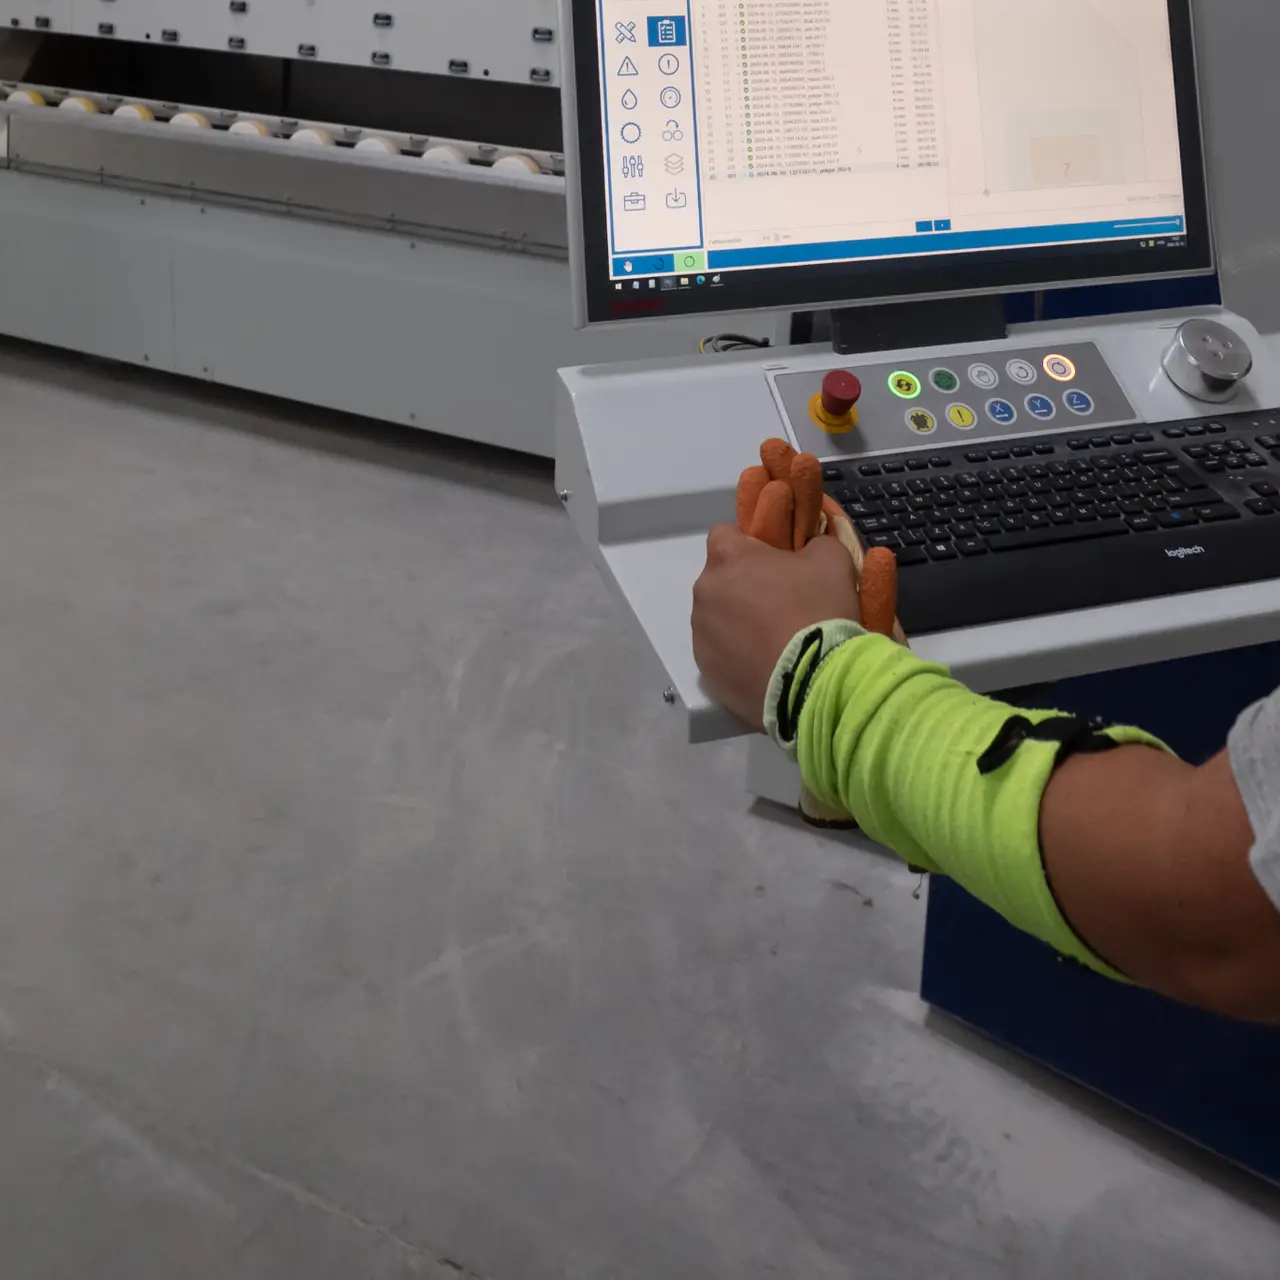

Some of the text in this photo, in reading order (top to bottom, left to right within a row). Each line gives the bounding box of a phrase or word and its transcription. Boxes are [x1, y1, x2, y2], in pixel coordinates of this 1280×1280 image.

[1063, 162, 1071, 178] 7
[994, 394, 1080, 413] X Y Z
[1164, 545, 1205, 559] logitech
